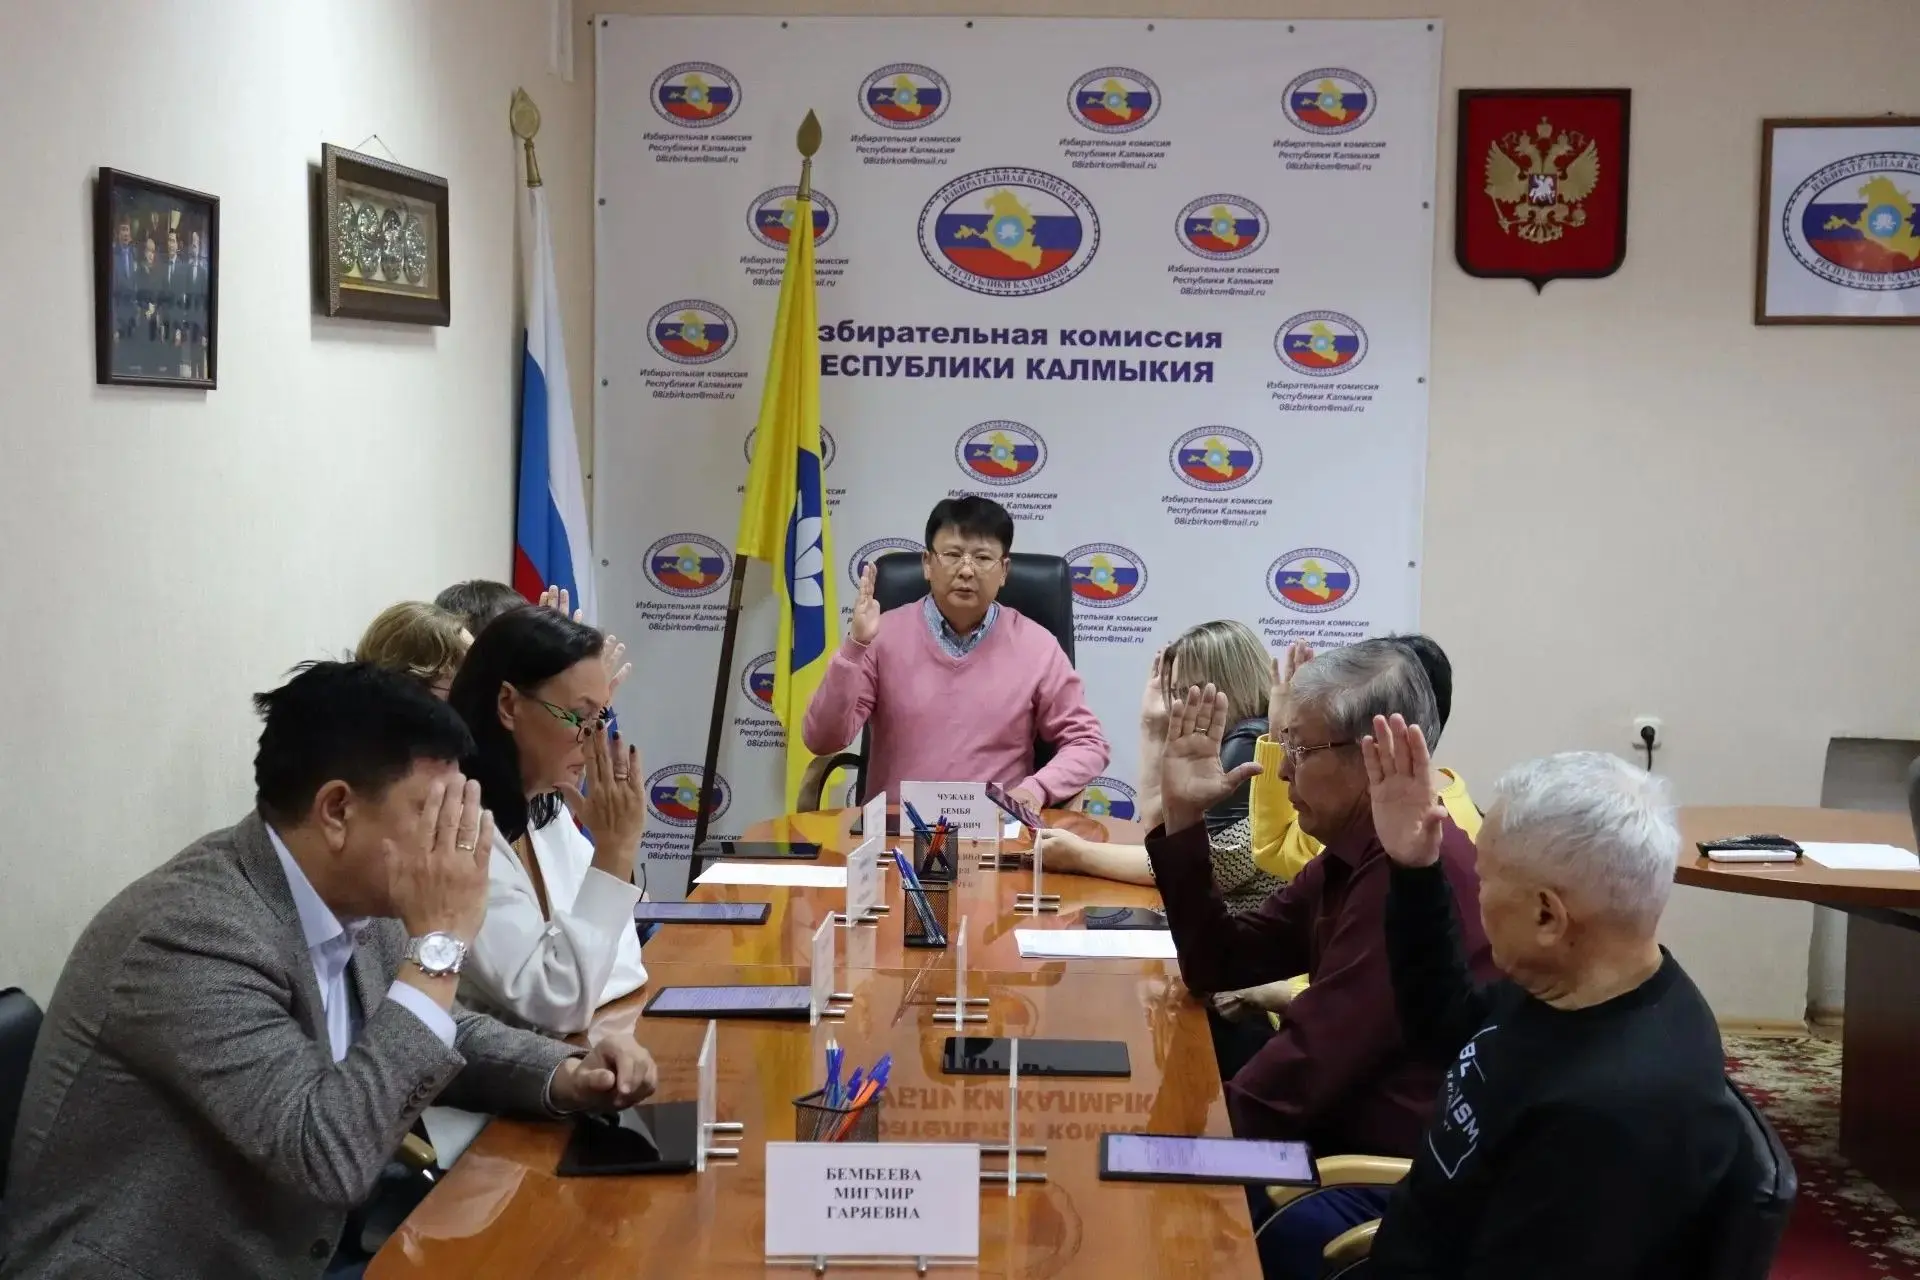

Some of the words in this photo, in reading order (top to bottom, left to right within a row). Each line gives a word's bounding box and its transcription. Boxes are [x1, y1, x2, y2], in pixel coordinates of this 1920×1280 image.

[942, 173, 1024, 204] ИЗБИРАТЕЛЬНАЯ
[1027, 175, 1081, 210] КОМИССИЯ
[947, 264, 1012, 289] РЕСПУБЛИКИ
[1013, 265, 1071, 289] КАЛМЫКИЯ
[817, 320, 1048, 348] збирательная
[1060, 328, 1222, 348] комиссия
[820, 355, 1014, 380] ЕСПУБЛИКИ
[1026, 358, 1214, 383] КАЛМЫКИЯ
[1267, 380, 1334, 392] Избирательная
[1336, 382, 1379, 390] комиссия
[1272, 392, 1322, 403] Республики
[1325, 393, 1373, 401] Калмыкия
[1016, 491, 1058, 499] комиссия
[1162, 495, 1229, 506] Избирательная
[1230, 496, 1273, 505] комиссия
[1167, 506, 1217, 517] Республики
[1219, 507, 1267, 516] Калмыкия
[636, 602, 701, 611] Избирательная
[641, 612, 691, 621] Республики
[1116, 614, 1158, 622] комиссия
[1106, 624, 1152, 632] Калмыкия
[1258, 617, 1325, 628] Избирательная
[1327, 619, 1369, 627] комиссия
[1264, 628, 1314, 639] Республики
[1316, 629, 1363, 638] Калмыкия
[941, 807, 971, 815] БЕМБЯ
[826, 1167, 922, 1181] БЕМБЕЕВА
[834, 1187, 914, 1200] МИГМИР
[826, 1206, 921, 1219] ГАРЯЕВНА
